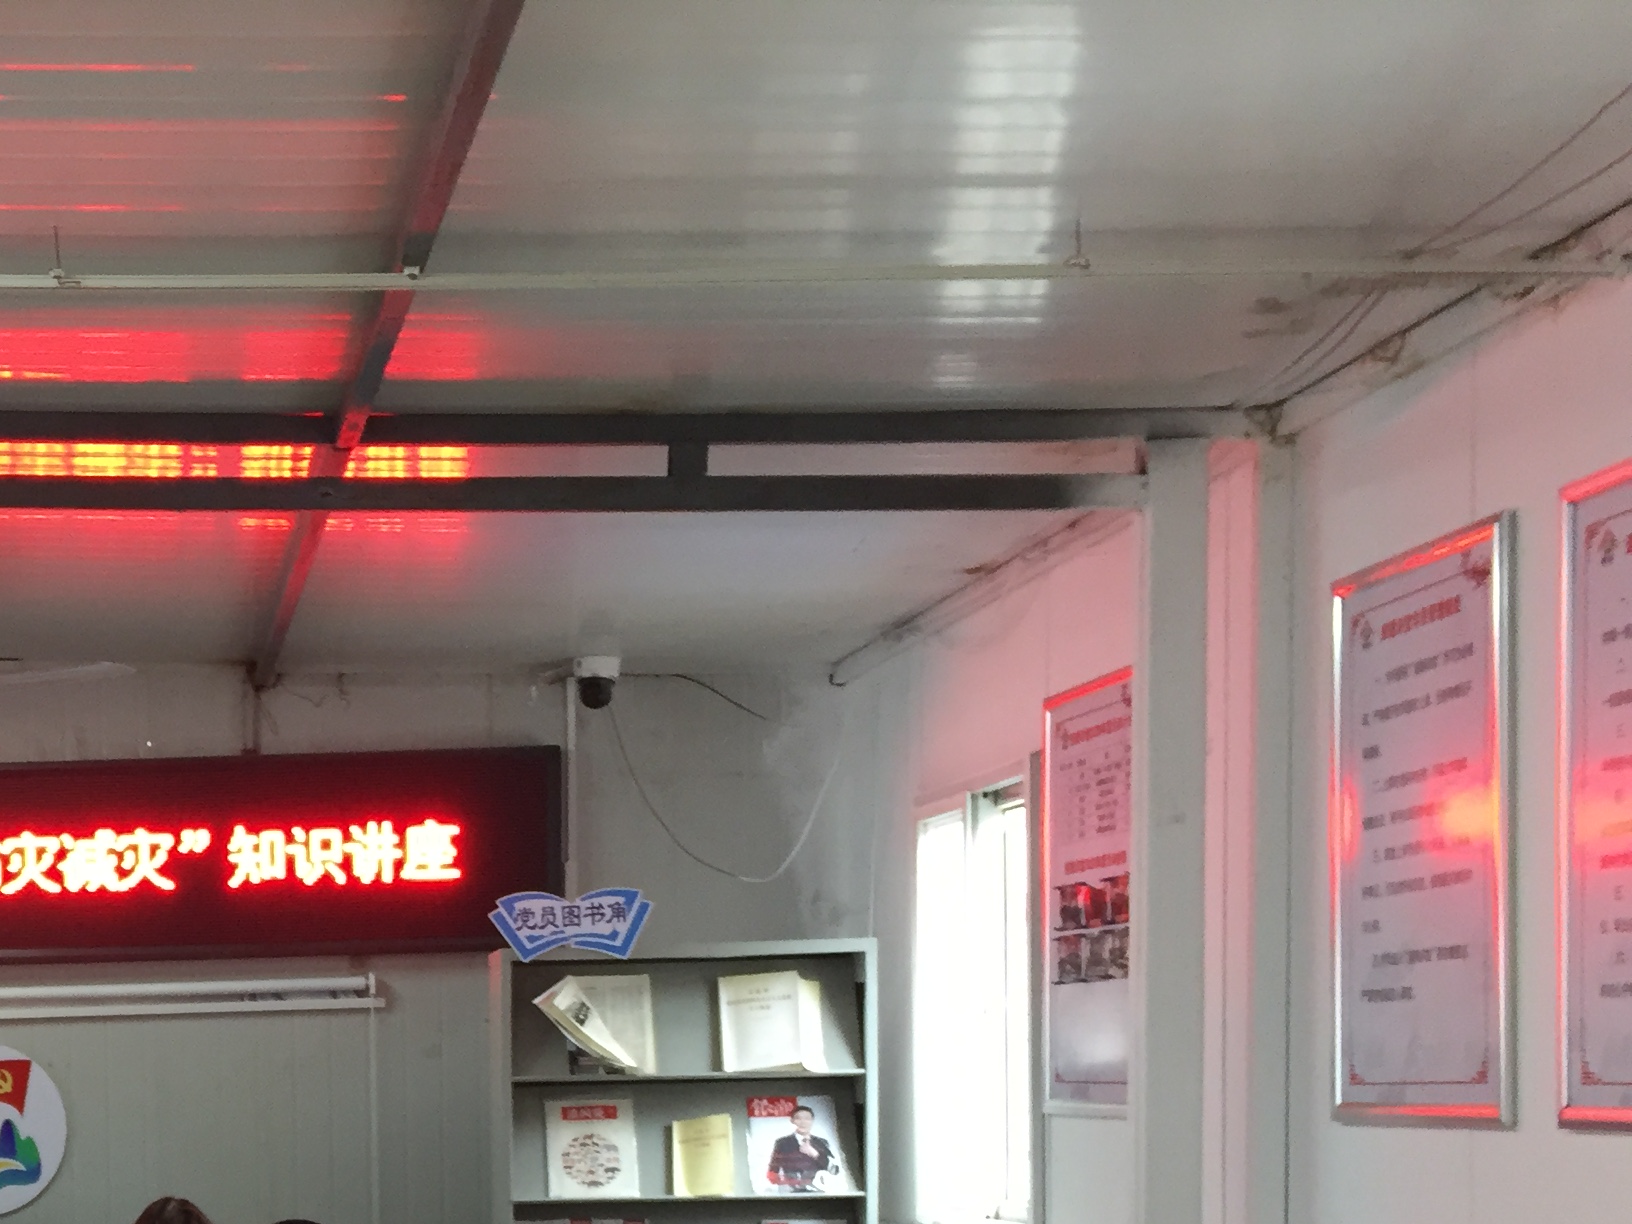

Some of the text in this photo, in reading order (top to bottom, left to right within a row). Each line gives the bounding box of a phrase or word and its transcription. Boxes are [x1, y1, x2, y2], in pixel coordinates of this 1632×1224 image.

[515, 900, 628, 932] 党员图书角
